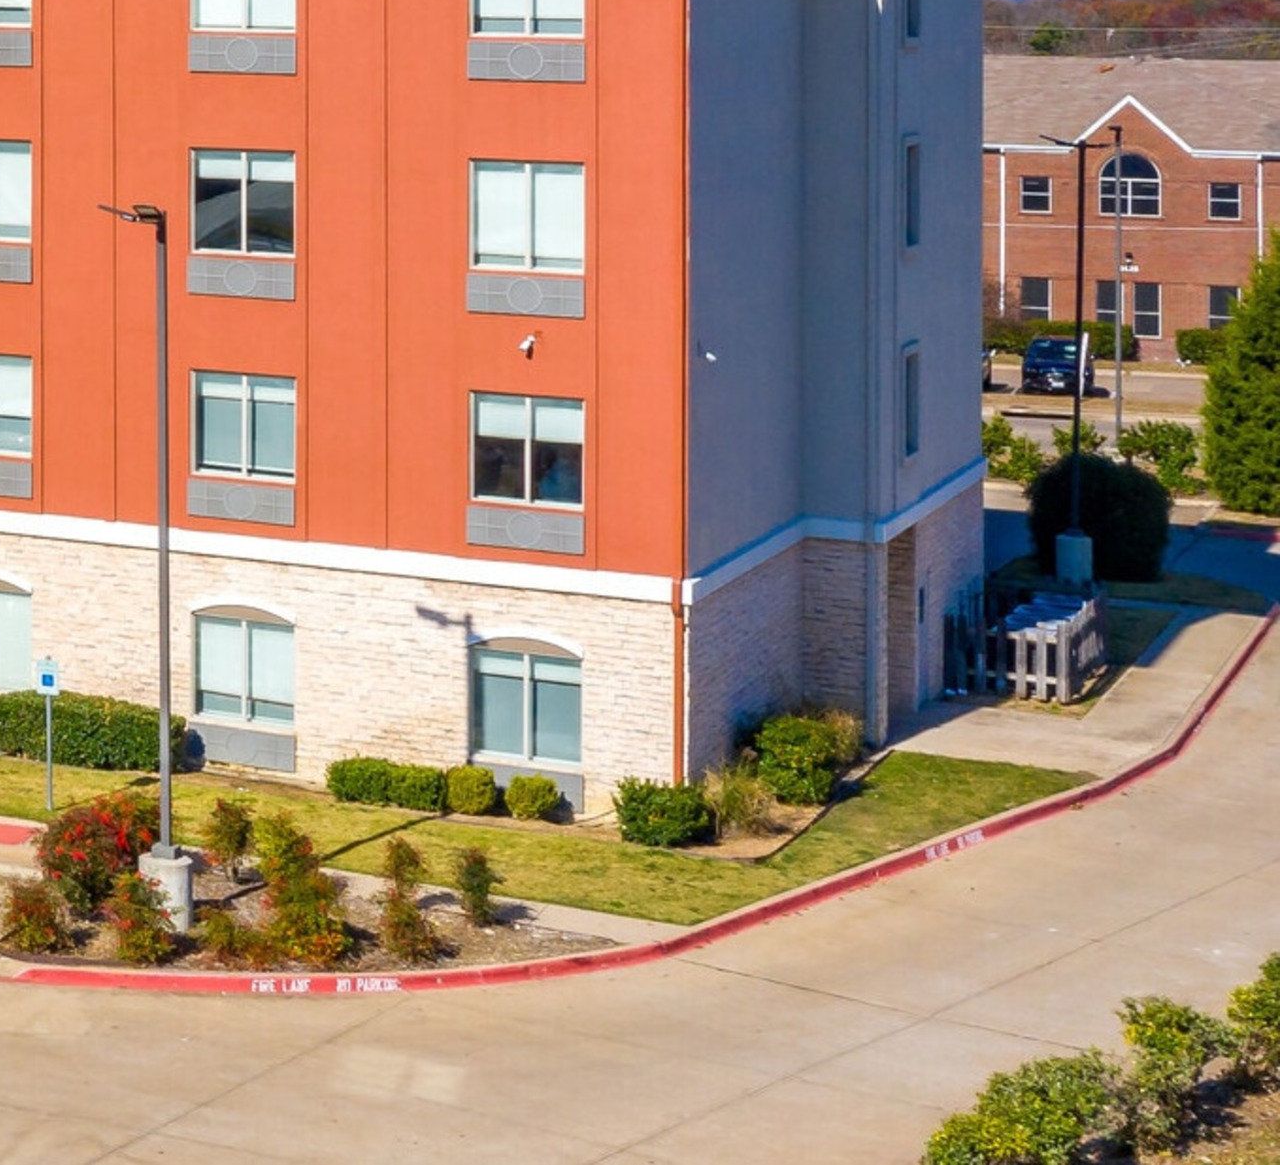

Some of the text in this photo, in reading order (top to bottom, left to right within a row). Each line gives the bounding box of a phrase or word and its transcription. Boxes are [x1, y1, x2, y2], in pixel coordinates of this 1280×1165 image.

[250, 976, 402, 993] FIRE LANE NO PARKING
